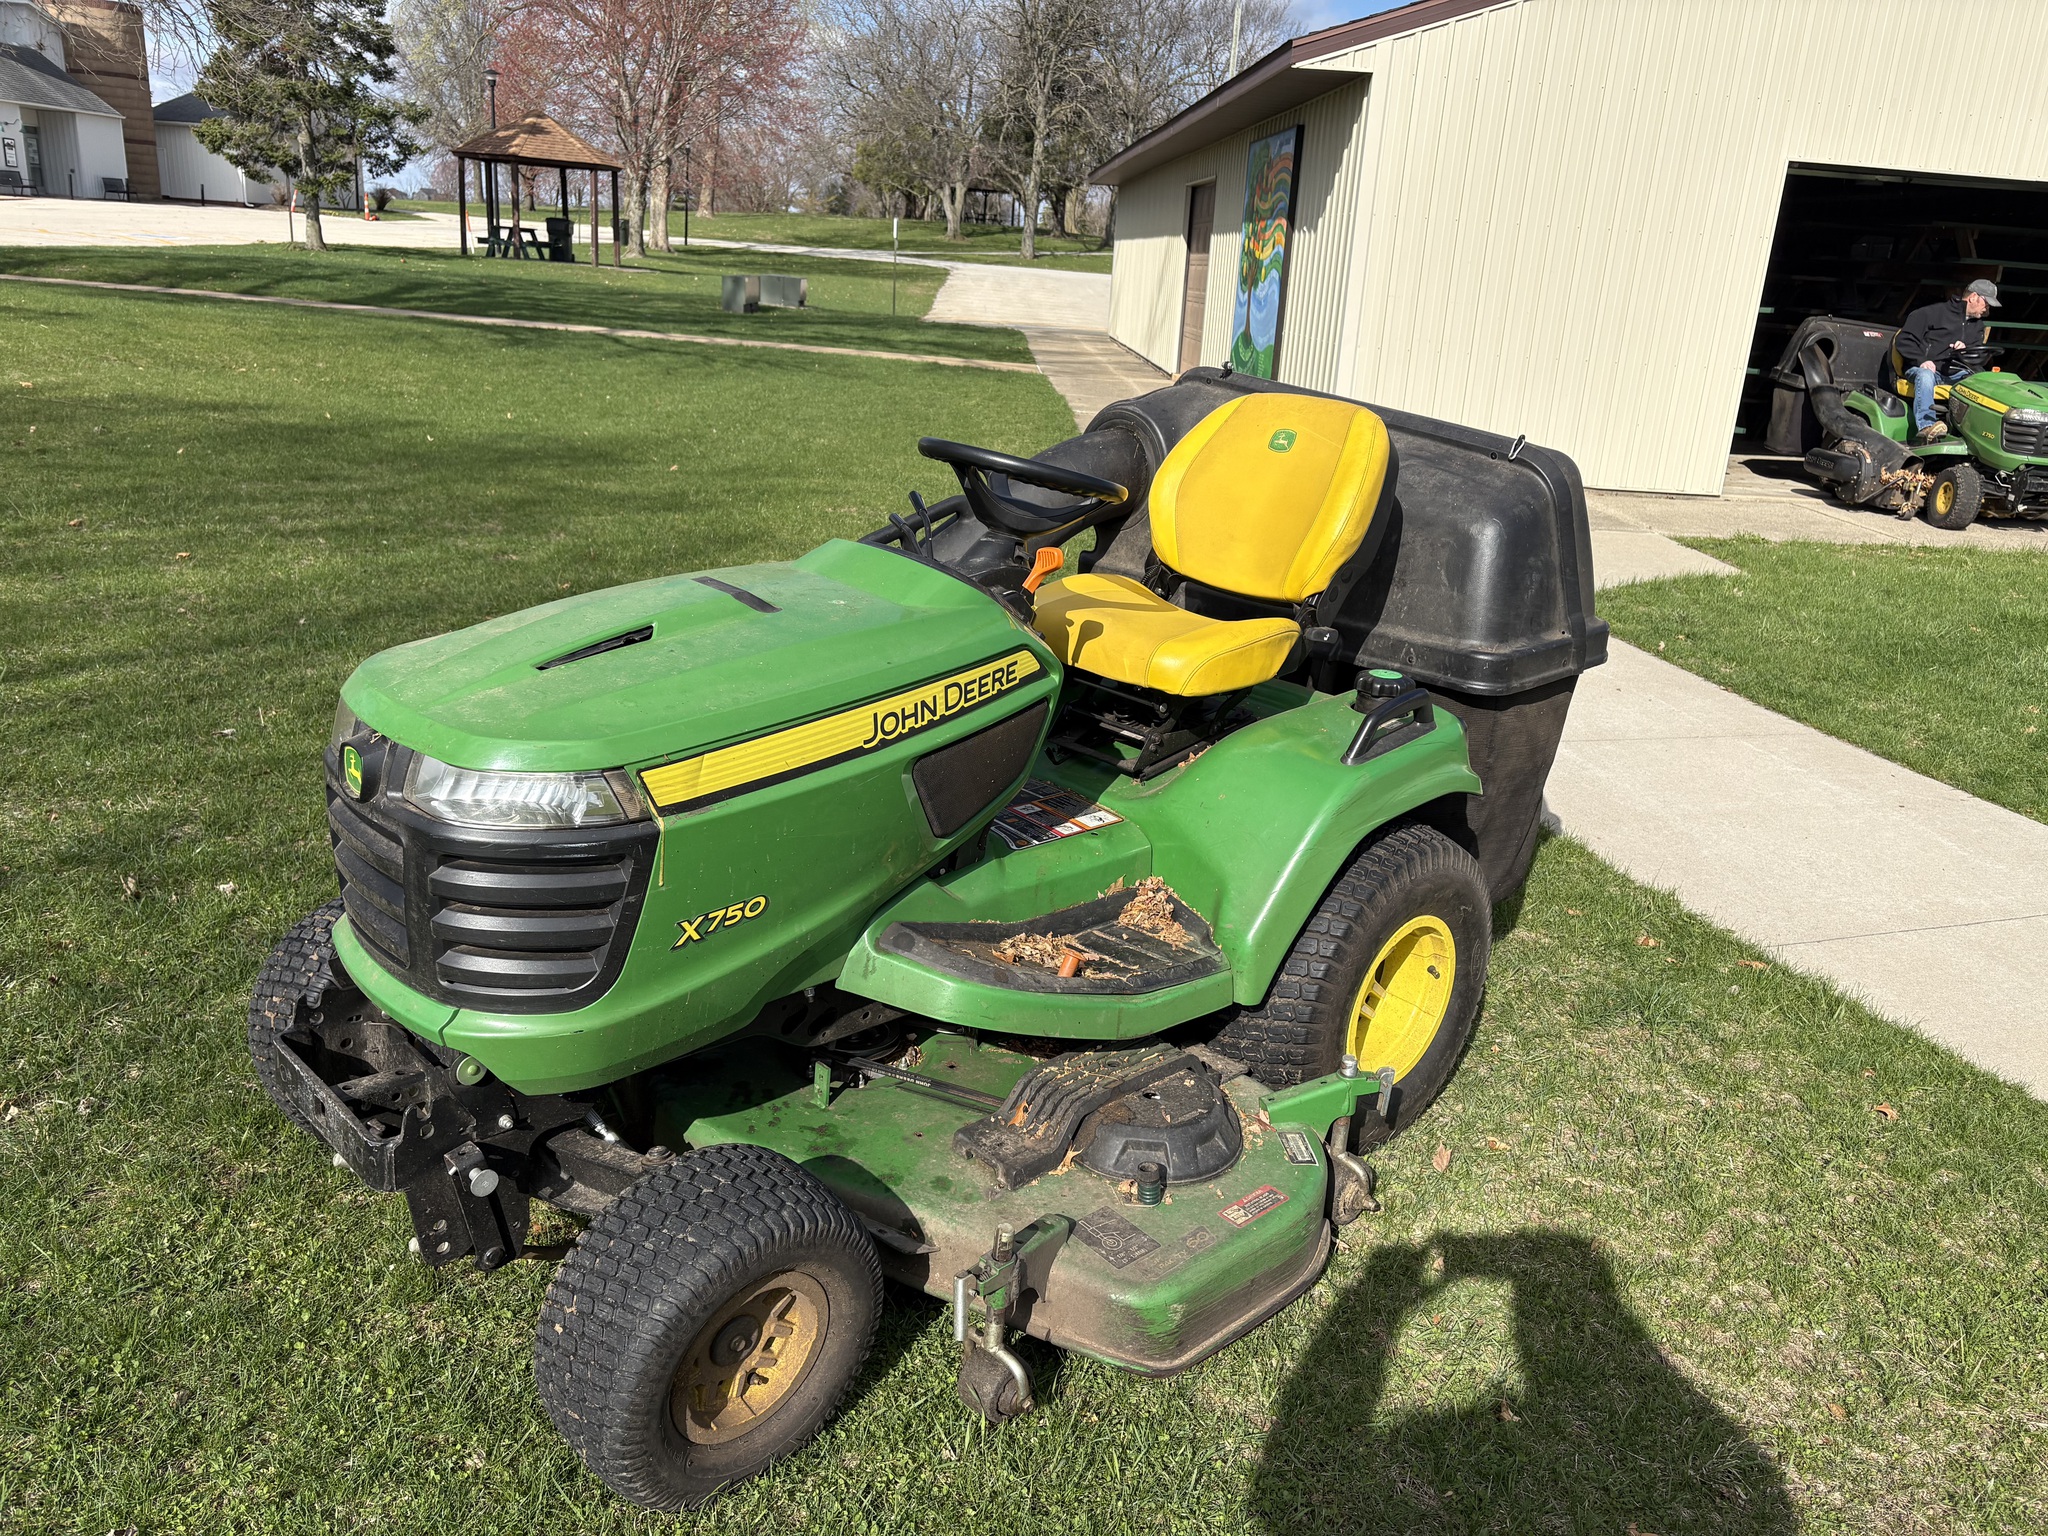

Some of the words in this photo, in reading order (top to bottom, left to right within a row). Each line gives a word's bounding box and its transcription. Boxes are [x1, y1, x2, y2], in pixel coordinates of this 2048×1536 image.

[1966, 390, 1980, 402] DEERE
[863, 694, 938, 746] JOHN
[944, 660, 1019, 713] DEERE
[672, 894, 768, 949] X750
[1186, 1231, 1209, 1248] 60
